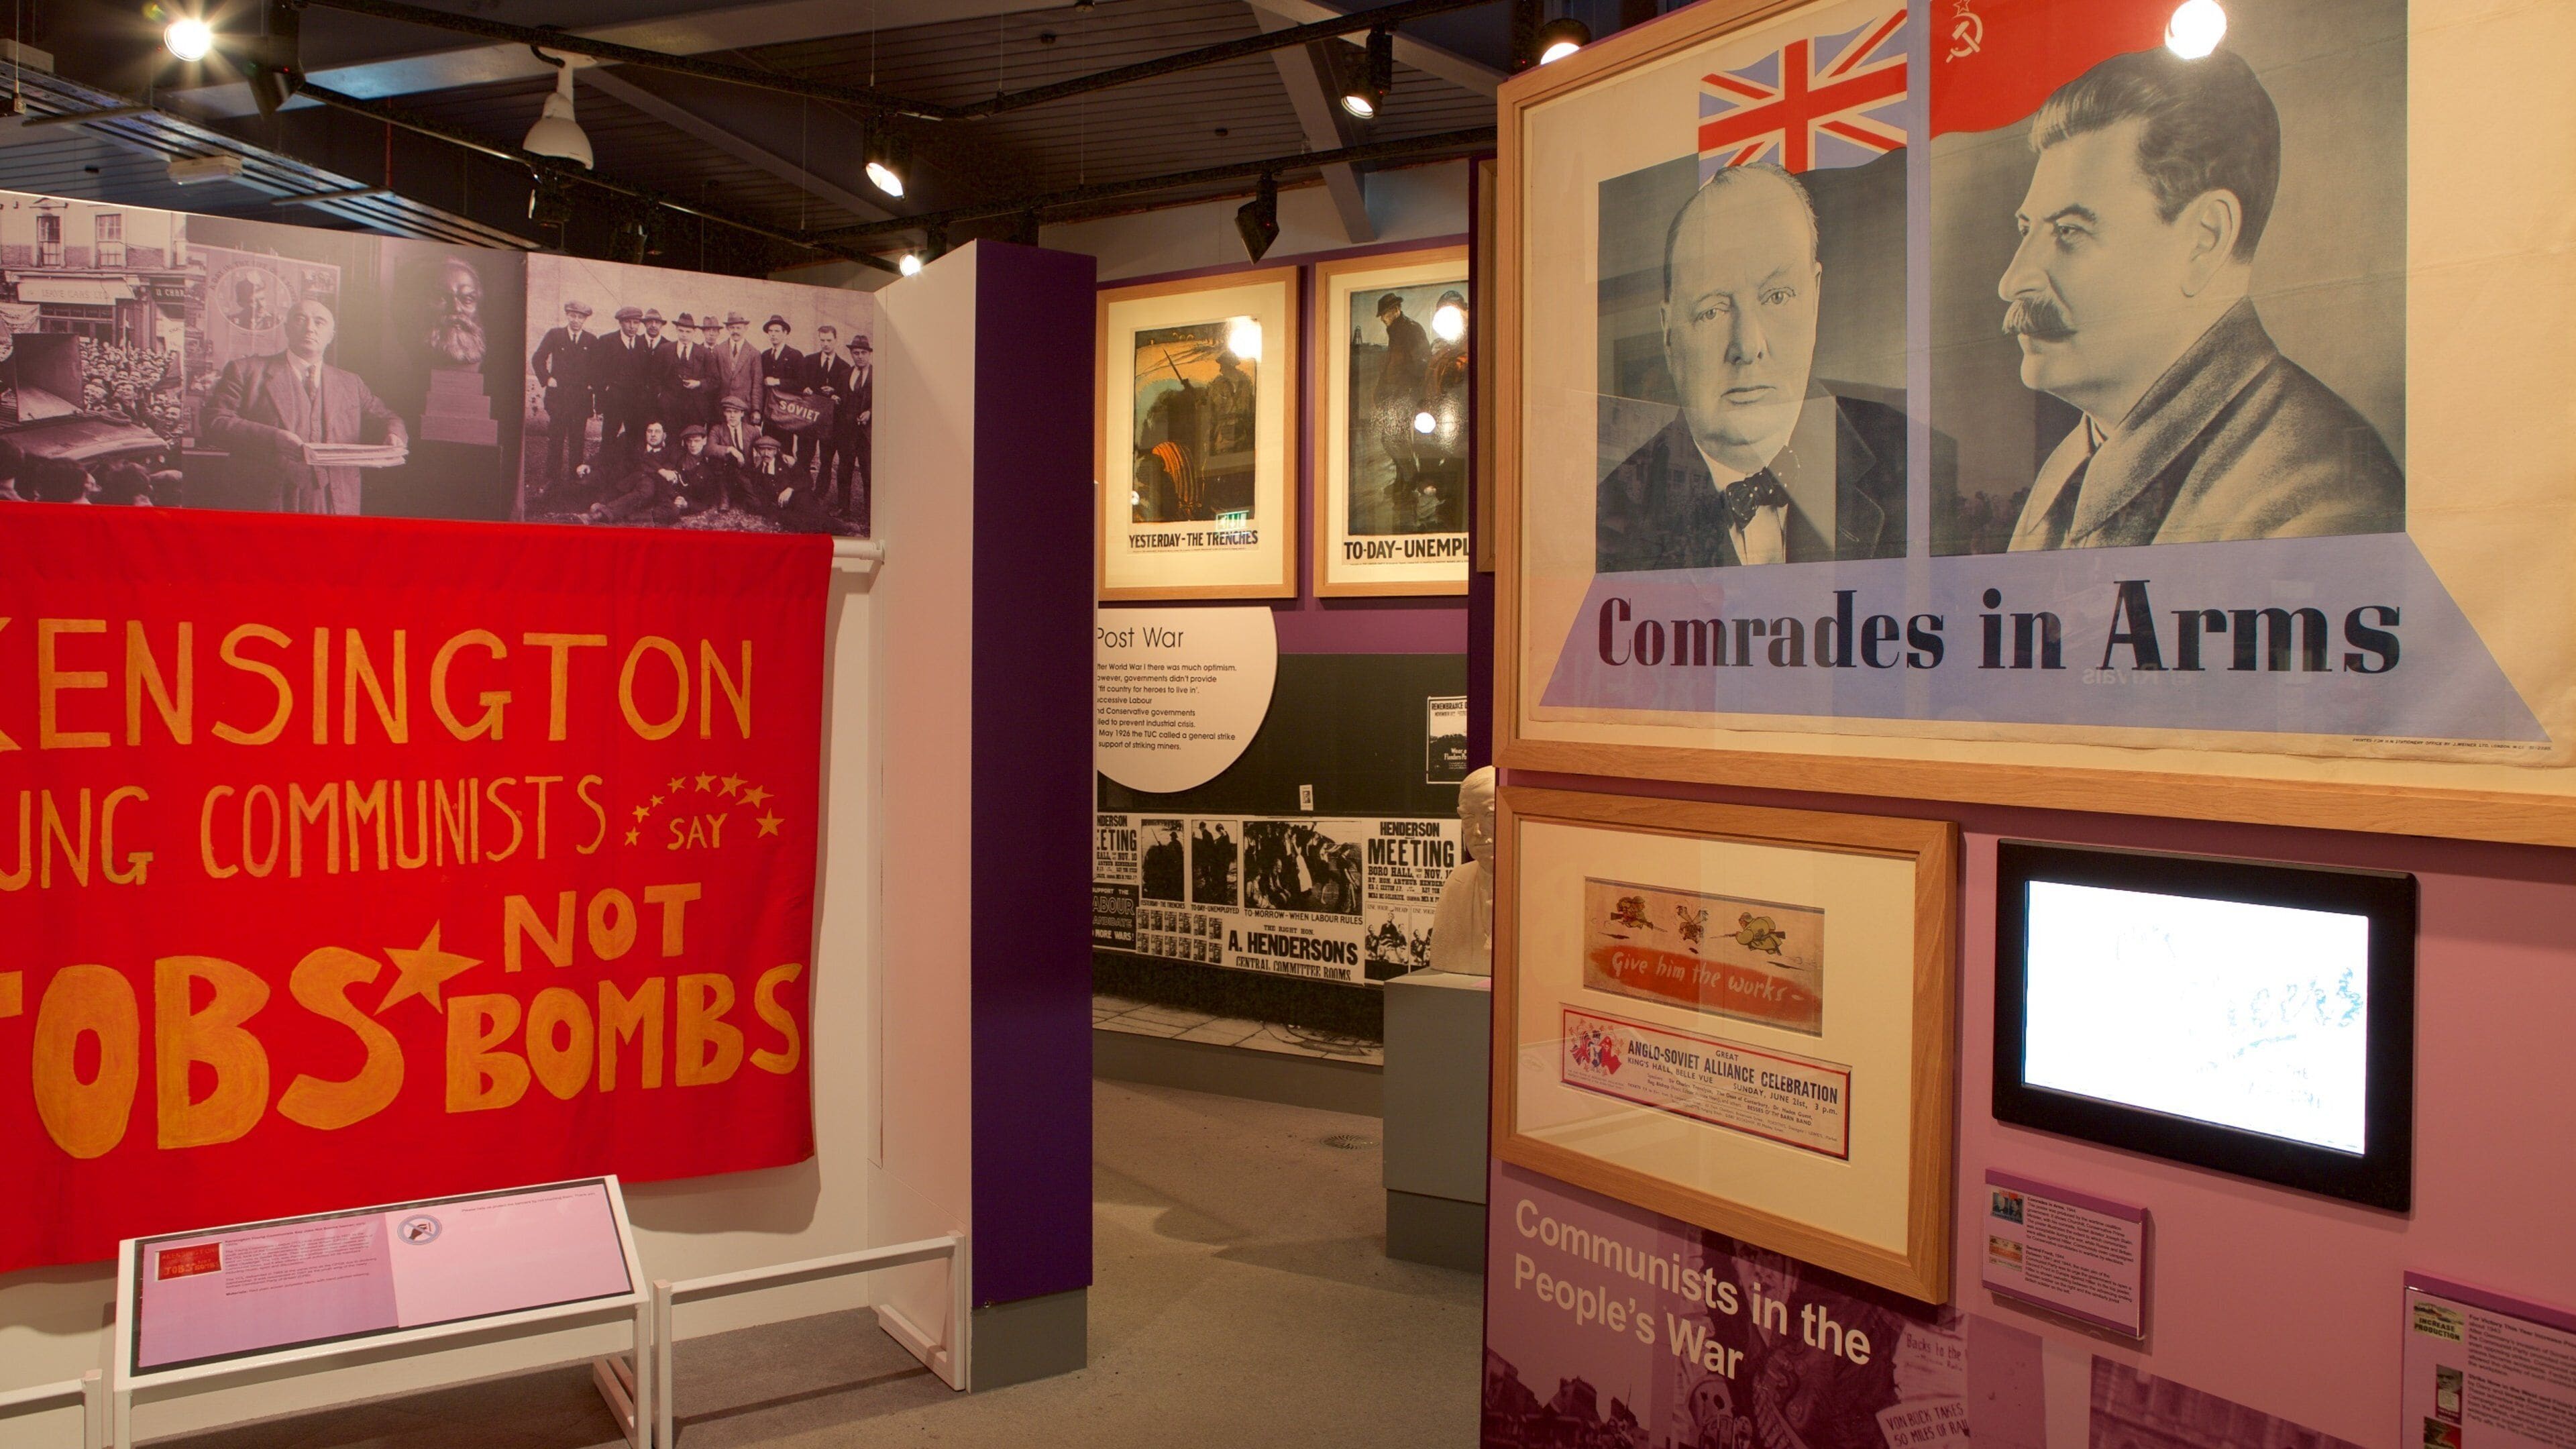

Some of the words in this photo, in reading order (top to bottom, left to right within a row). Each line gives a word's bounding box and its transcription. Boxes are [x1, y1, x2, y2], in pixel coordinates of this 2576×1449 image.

[779, 400, 820, 423] SOVIET
[1206, 530, 1258, 546] TRENCHES
[1599, 590, 1945, 669] Comrades
[1979, 587, 2067, 669] in
[2096, 579, 2400, 674] Arms
[1142, 627, 1183, 648] War
[1203, 664, 1237, 672] optimism.
[1107, 686, 1131, 694] country
[1124, 676, 1168, 684] governments
[1190, 676, 1217, 684] provide
[1119, 719, 1144, 727] prevent
[1151, 709, 1195, 717] governments
[1099, 729, 1114, 738] May
[1116, 729, 1130, 737] 1926
[1159, 731, 1181, 739] called
[1189, 731, 1216, 741] general
[1217, 733, 1236, 741] strike
[1098, 741, 1123, 749] support
[1132, 742, 1156, 751] striking
[1157, 743, 1181, 751] miners.
[201, 774, 606, 878] COMMUNISTS
[667, 812, 729, 851] SAY
[1380, 821, 1440, 837] HENDERSON
[1368, 838, 1454, 868] MEETING
[1368, 866, 1388, 876] BORO
[1424, 869, 1442, 879] NOV.
[1393, 878, 1417, 886] ARTHUR
[1093, 896, 1134, 915] ABOUR
[504, 881, 702, 973] NOT
[1279, 926, 1297, 934] RIGHT
[1311, 914, 1338, 924] LABOUR
[1340, 916, 1364, 925] RULES
[1095, 929, 1112, 938] MORE
[1228, 930, 1242, 952] A.
[1248, 932, 1358, 966] HENDERSON'S
[1236, 956, 1271, 971] CENTRAL
[1274, 959, 1321, 975] COMMITTEE
[1324, 966, 1351, 981] ROOMS
[1611, 951, 1648, 977] Give
[1656, 953, 1685, 982] him
[1693, 961, 1722, 988] the
[445, 963, 803, 1113] BOMBS
[0, 947, 405, 1159] OBS
[1715, 1050, 1739, 1061] GREAT
[1627, 1057, 1650, 1069] KING'S
[1652, 1063, 1674, 1075] HALL,
[1676, 1068, 1696, 1079] BELLE
[1699, 1073, 1714, 1084] VUE
[1627, 1040, 1700, 1071] ANGLO-SOVIET
[1704, 1058, 1755, 1084] ALLIANCE
[1760, 1071, 1838, 1105] CELEBRATION
[1733, 1082, 1767, 1099] SUNDAY,
[1770, 1092, 1790, 1104] JUNE
[1814, 1103, 1819, 1111] 3
[1822, 1106, 1838, 1116] p.m.
[1514, 1198, 1739, 1316] Communists
[1751, 1282, 1788, 1336] in
[1801, 1302, 1871, 1367] the
[1514, 1252, 1657, 1346] People's
[1665, 1313, 1744, 1381] War
[2418, 1317, 2455, 1332] INCREASE
[2414, 1324, 2461, 1341] PRODUCTION
[1886, 1414, 1908, 1431] VON
[1933, 1403, 1964, 1419] TAKES
[1894, 1433, 1909, 1446] 50
[1910, 1426, 1935, 1443] MILES
[1936, 1423, 1947, 1438] OF
